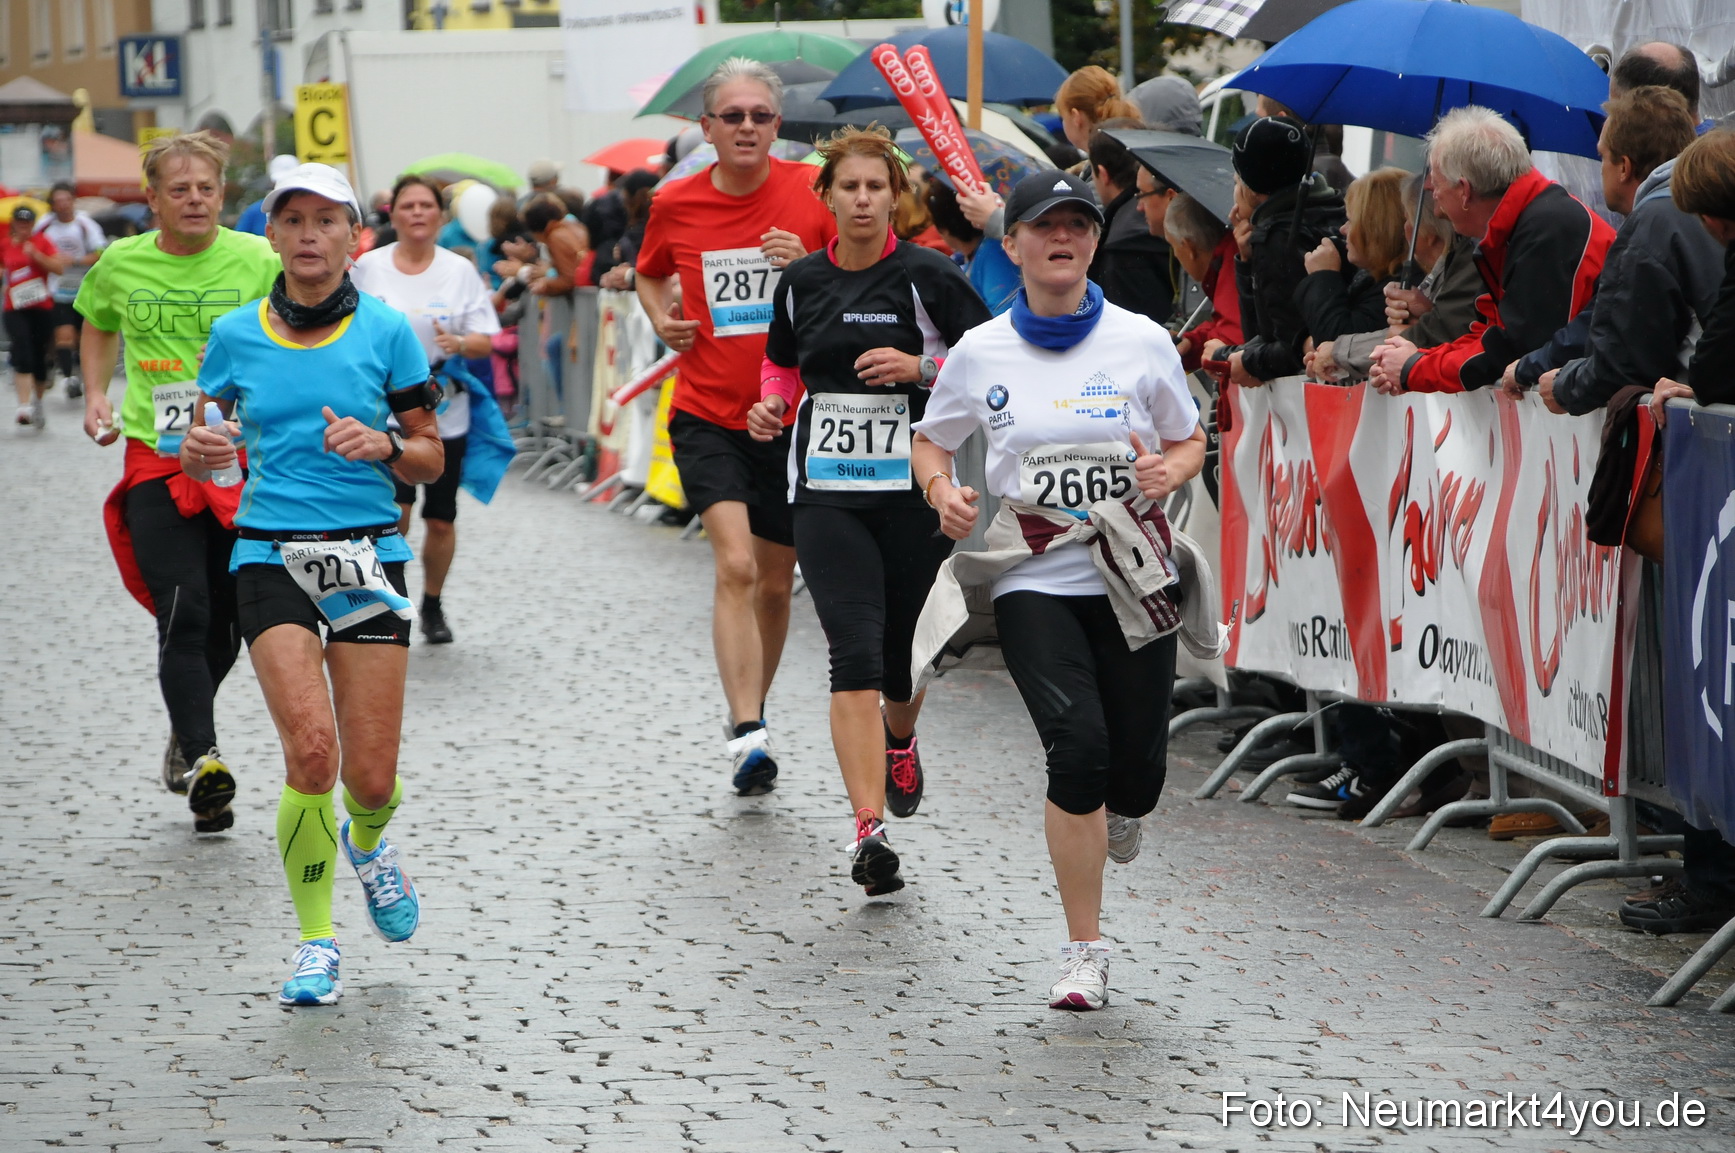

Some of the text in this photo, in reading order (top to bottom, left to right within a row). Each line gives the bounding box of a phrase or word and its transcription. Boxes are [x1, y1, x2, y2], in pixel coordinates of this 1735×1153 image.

[309, 108, 336, 146] C
[916, 108, 952, 150] BKK
[704, 258, 735, 268] PARTL
[714, 267, 784, 302] 287
[851, 313, 898, 323] PFLEIDERER
[154, 388, 184, 402] PARTL
[814, 402, 891, 414] PARTL Neumarkt
[165, 402, 196, 431] 21
[989, 411, 1015, 425] PARTL
[817, 417, 899, 454] 2517
[1022, 453, 1121, 466] PARTL Neumarkt
[837, 463, 876, 477] Silvia
[1033, 465, 1132, 508] 2665
[285, 546, 320, 564] PARTL
